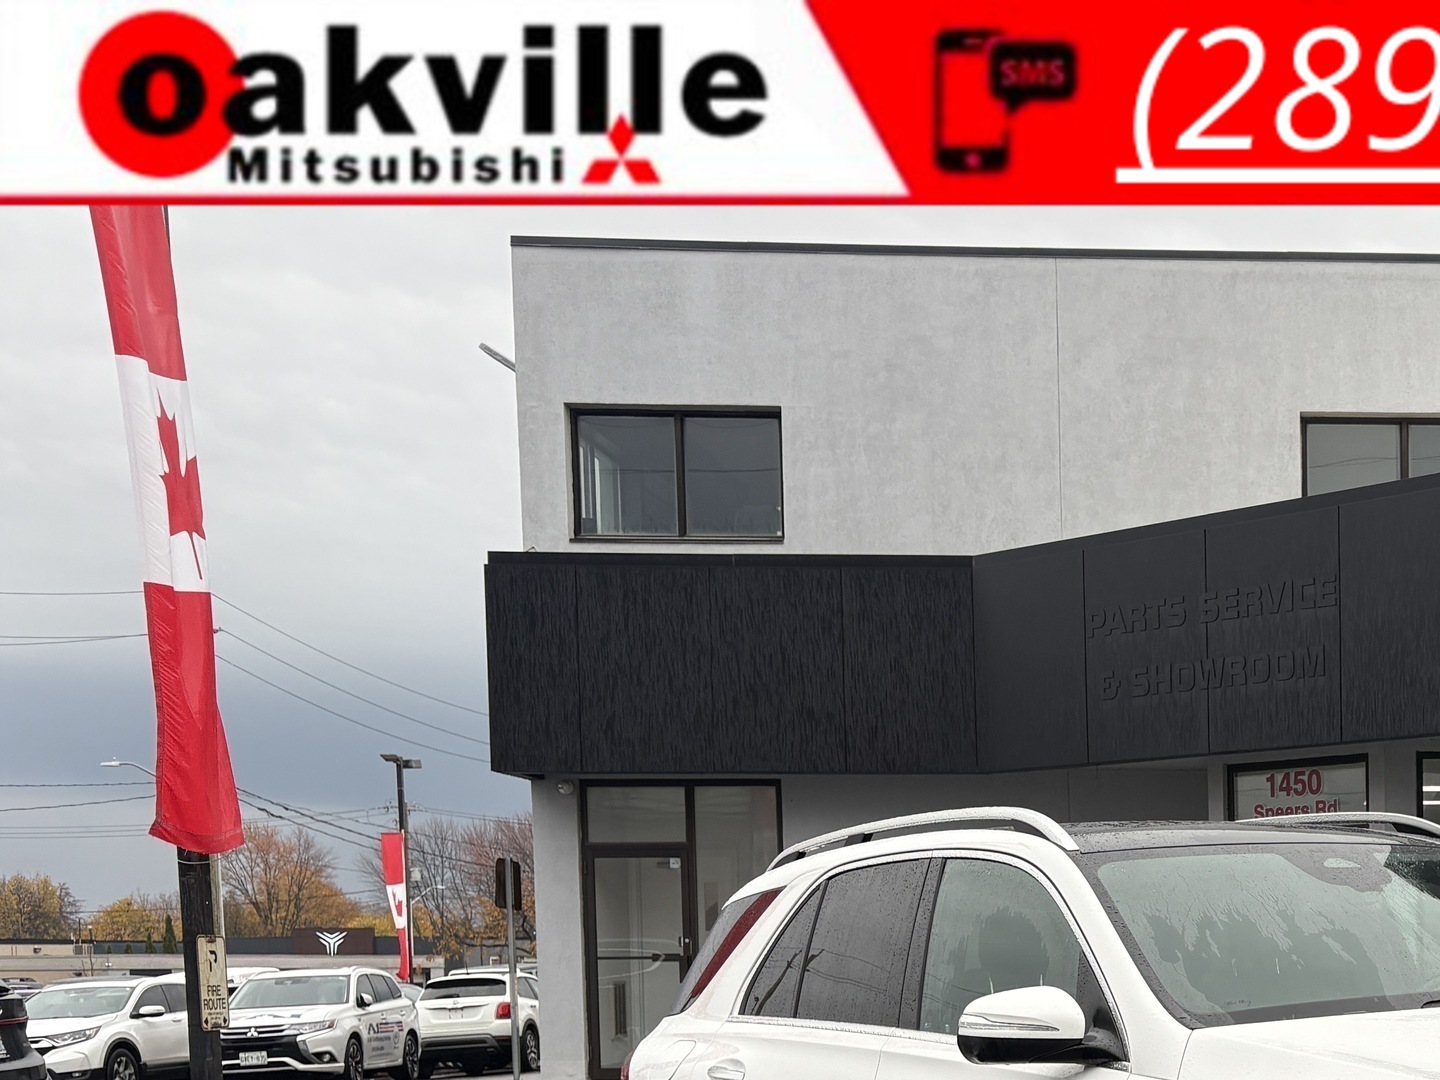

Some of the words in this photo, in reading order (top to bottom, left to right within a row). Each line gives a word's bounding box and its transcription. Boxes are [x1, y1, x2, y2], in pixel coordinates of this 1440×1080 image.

[1087, 596, 1187, 639] PARTS
[1201, 574, 1338, 624] SERVICE
[1131, 645, 1326, 698] SHOWROOM
[1265, 768, 1323, 798] 1450
[203, 998, 227, 1011] ROUTE
[207, 984, 222, 997] FIRE
